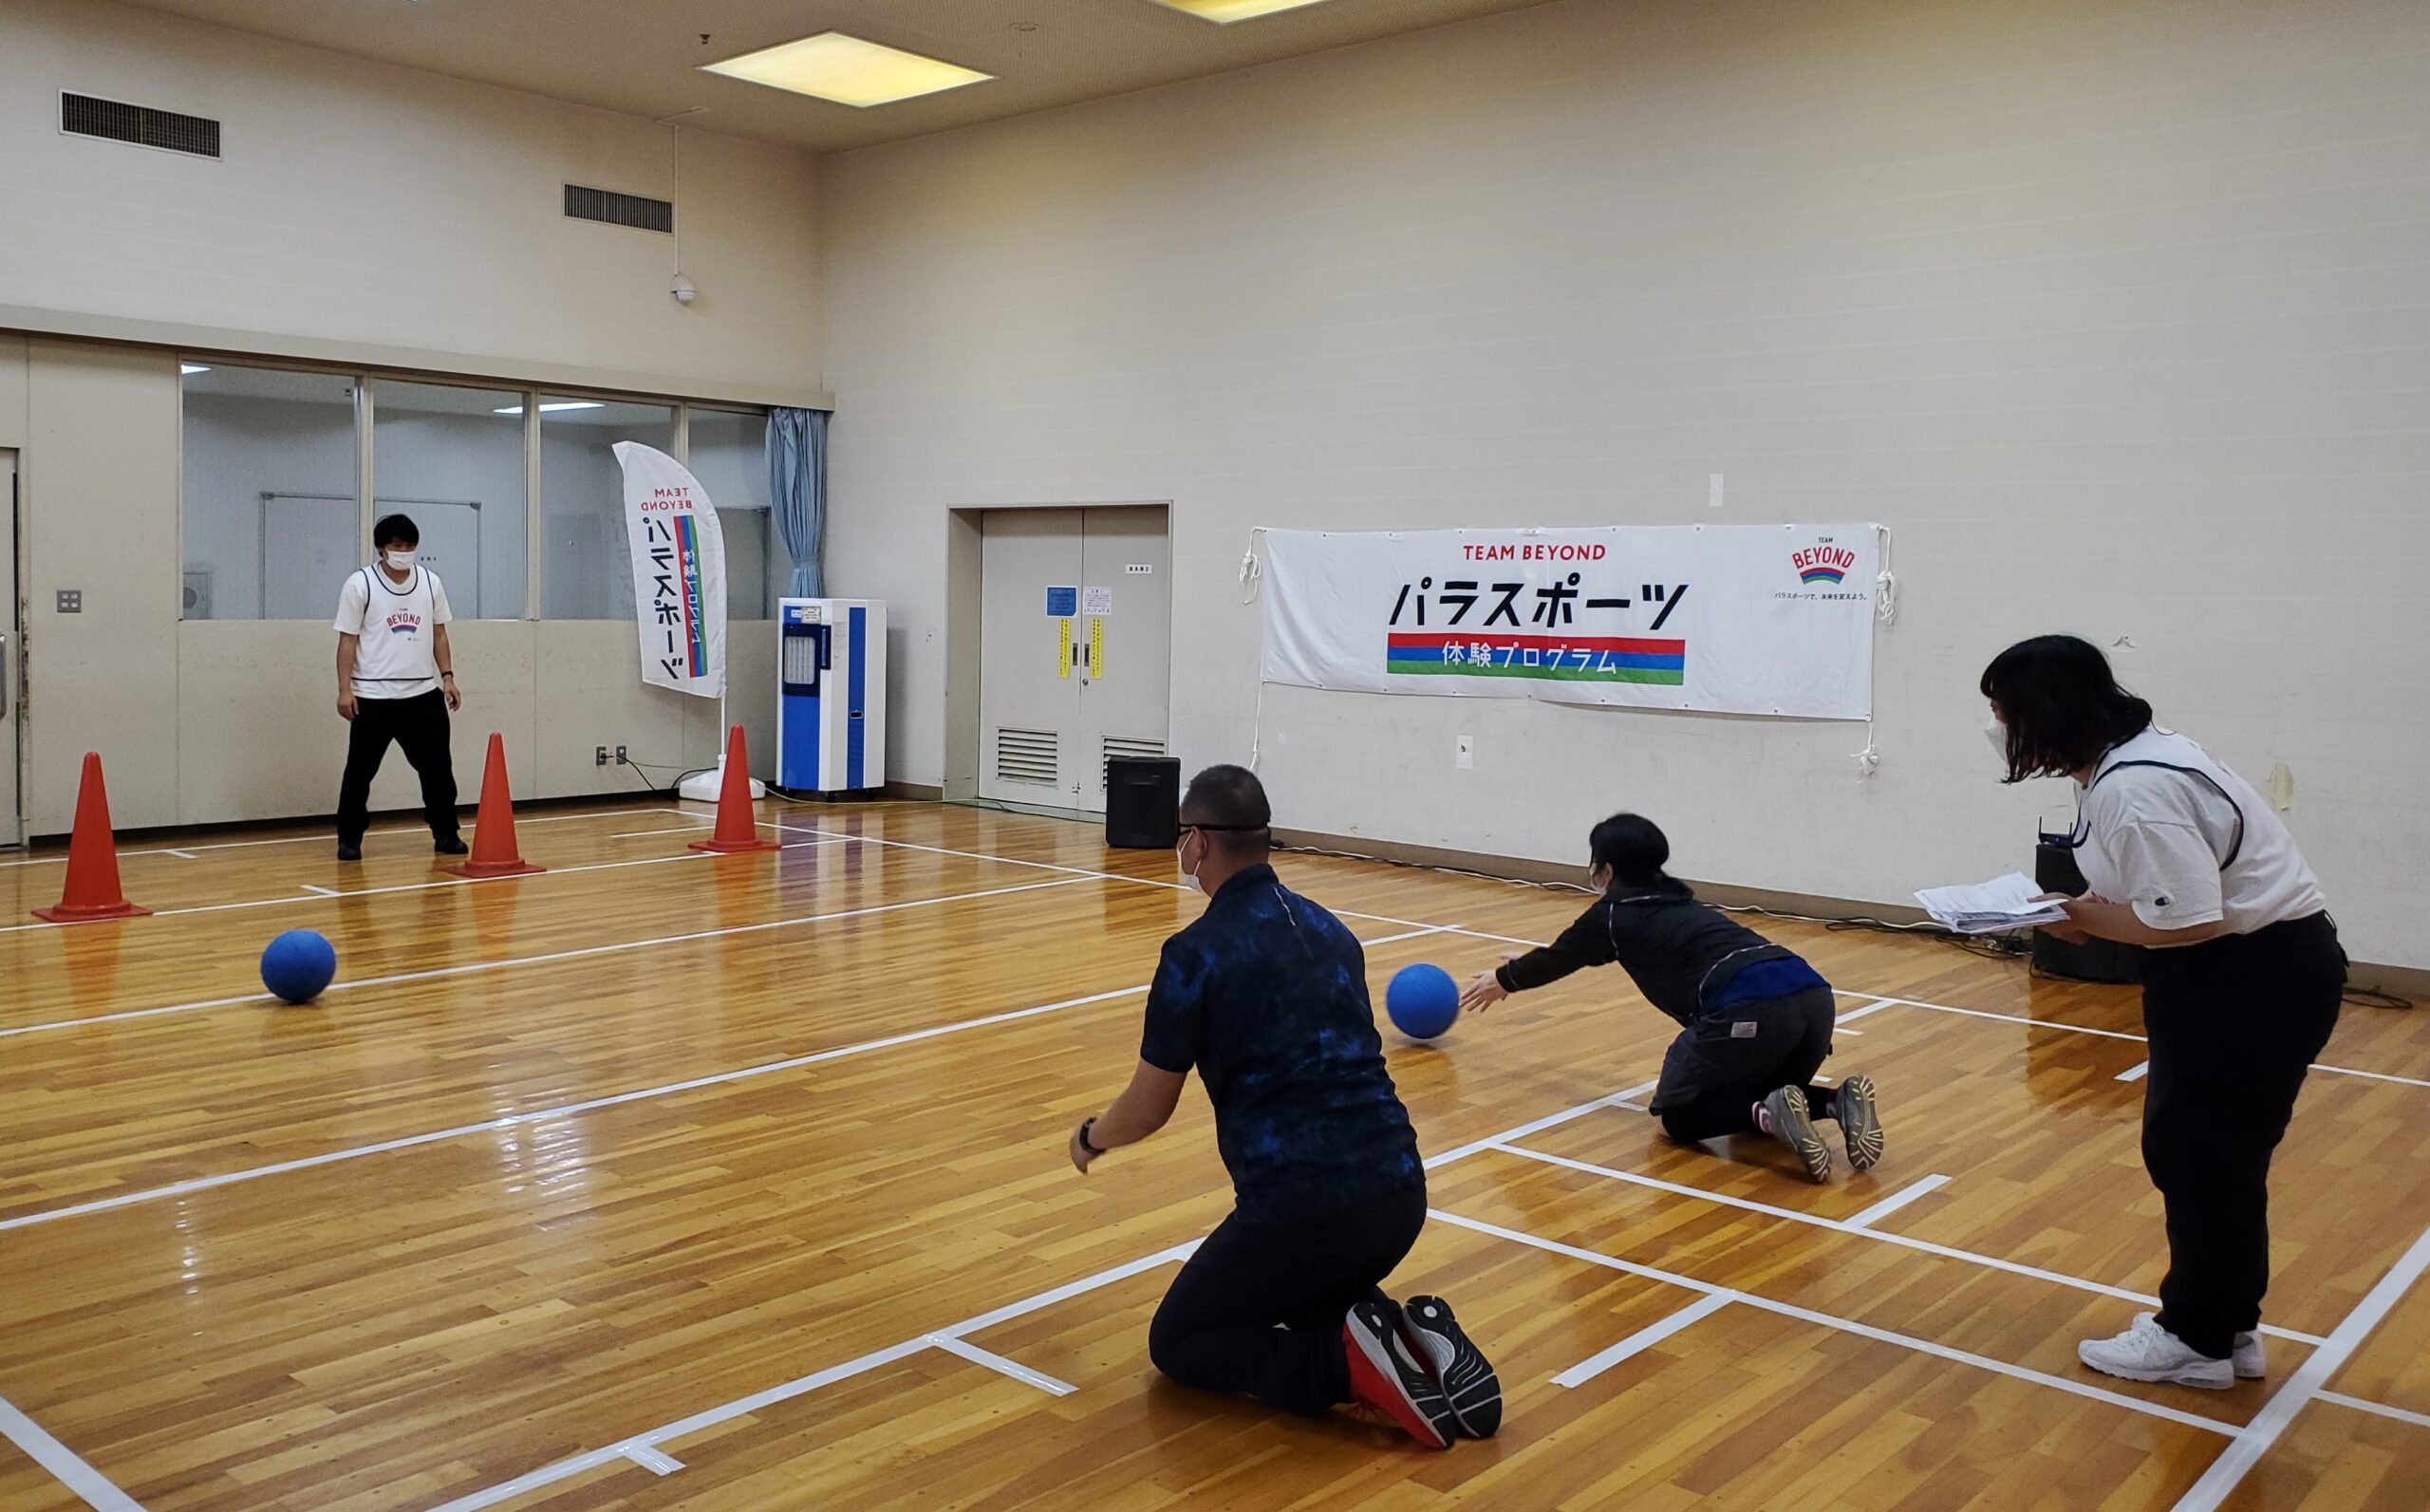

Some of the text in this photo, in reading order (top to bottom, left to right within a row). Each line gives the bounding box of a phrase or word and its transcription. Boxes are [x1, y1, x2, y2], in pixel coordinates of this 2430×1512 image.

[1463, 544, 1606, 561] TEAM BEYOND
[1792, 546, 1855, 569] BEYOND
[1388, 571, 1690, 630] パラスポーツ
[386, 613, 421, 626] BEYOND
[1441, 640, 1617, 675] 体験プログラム
